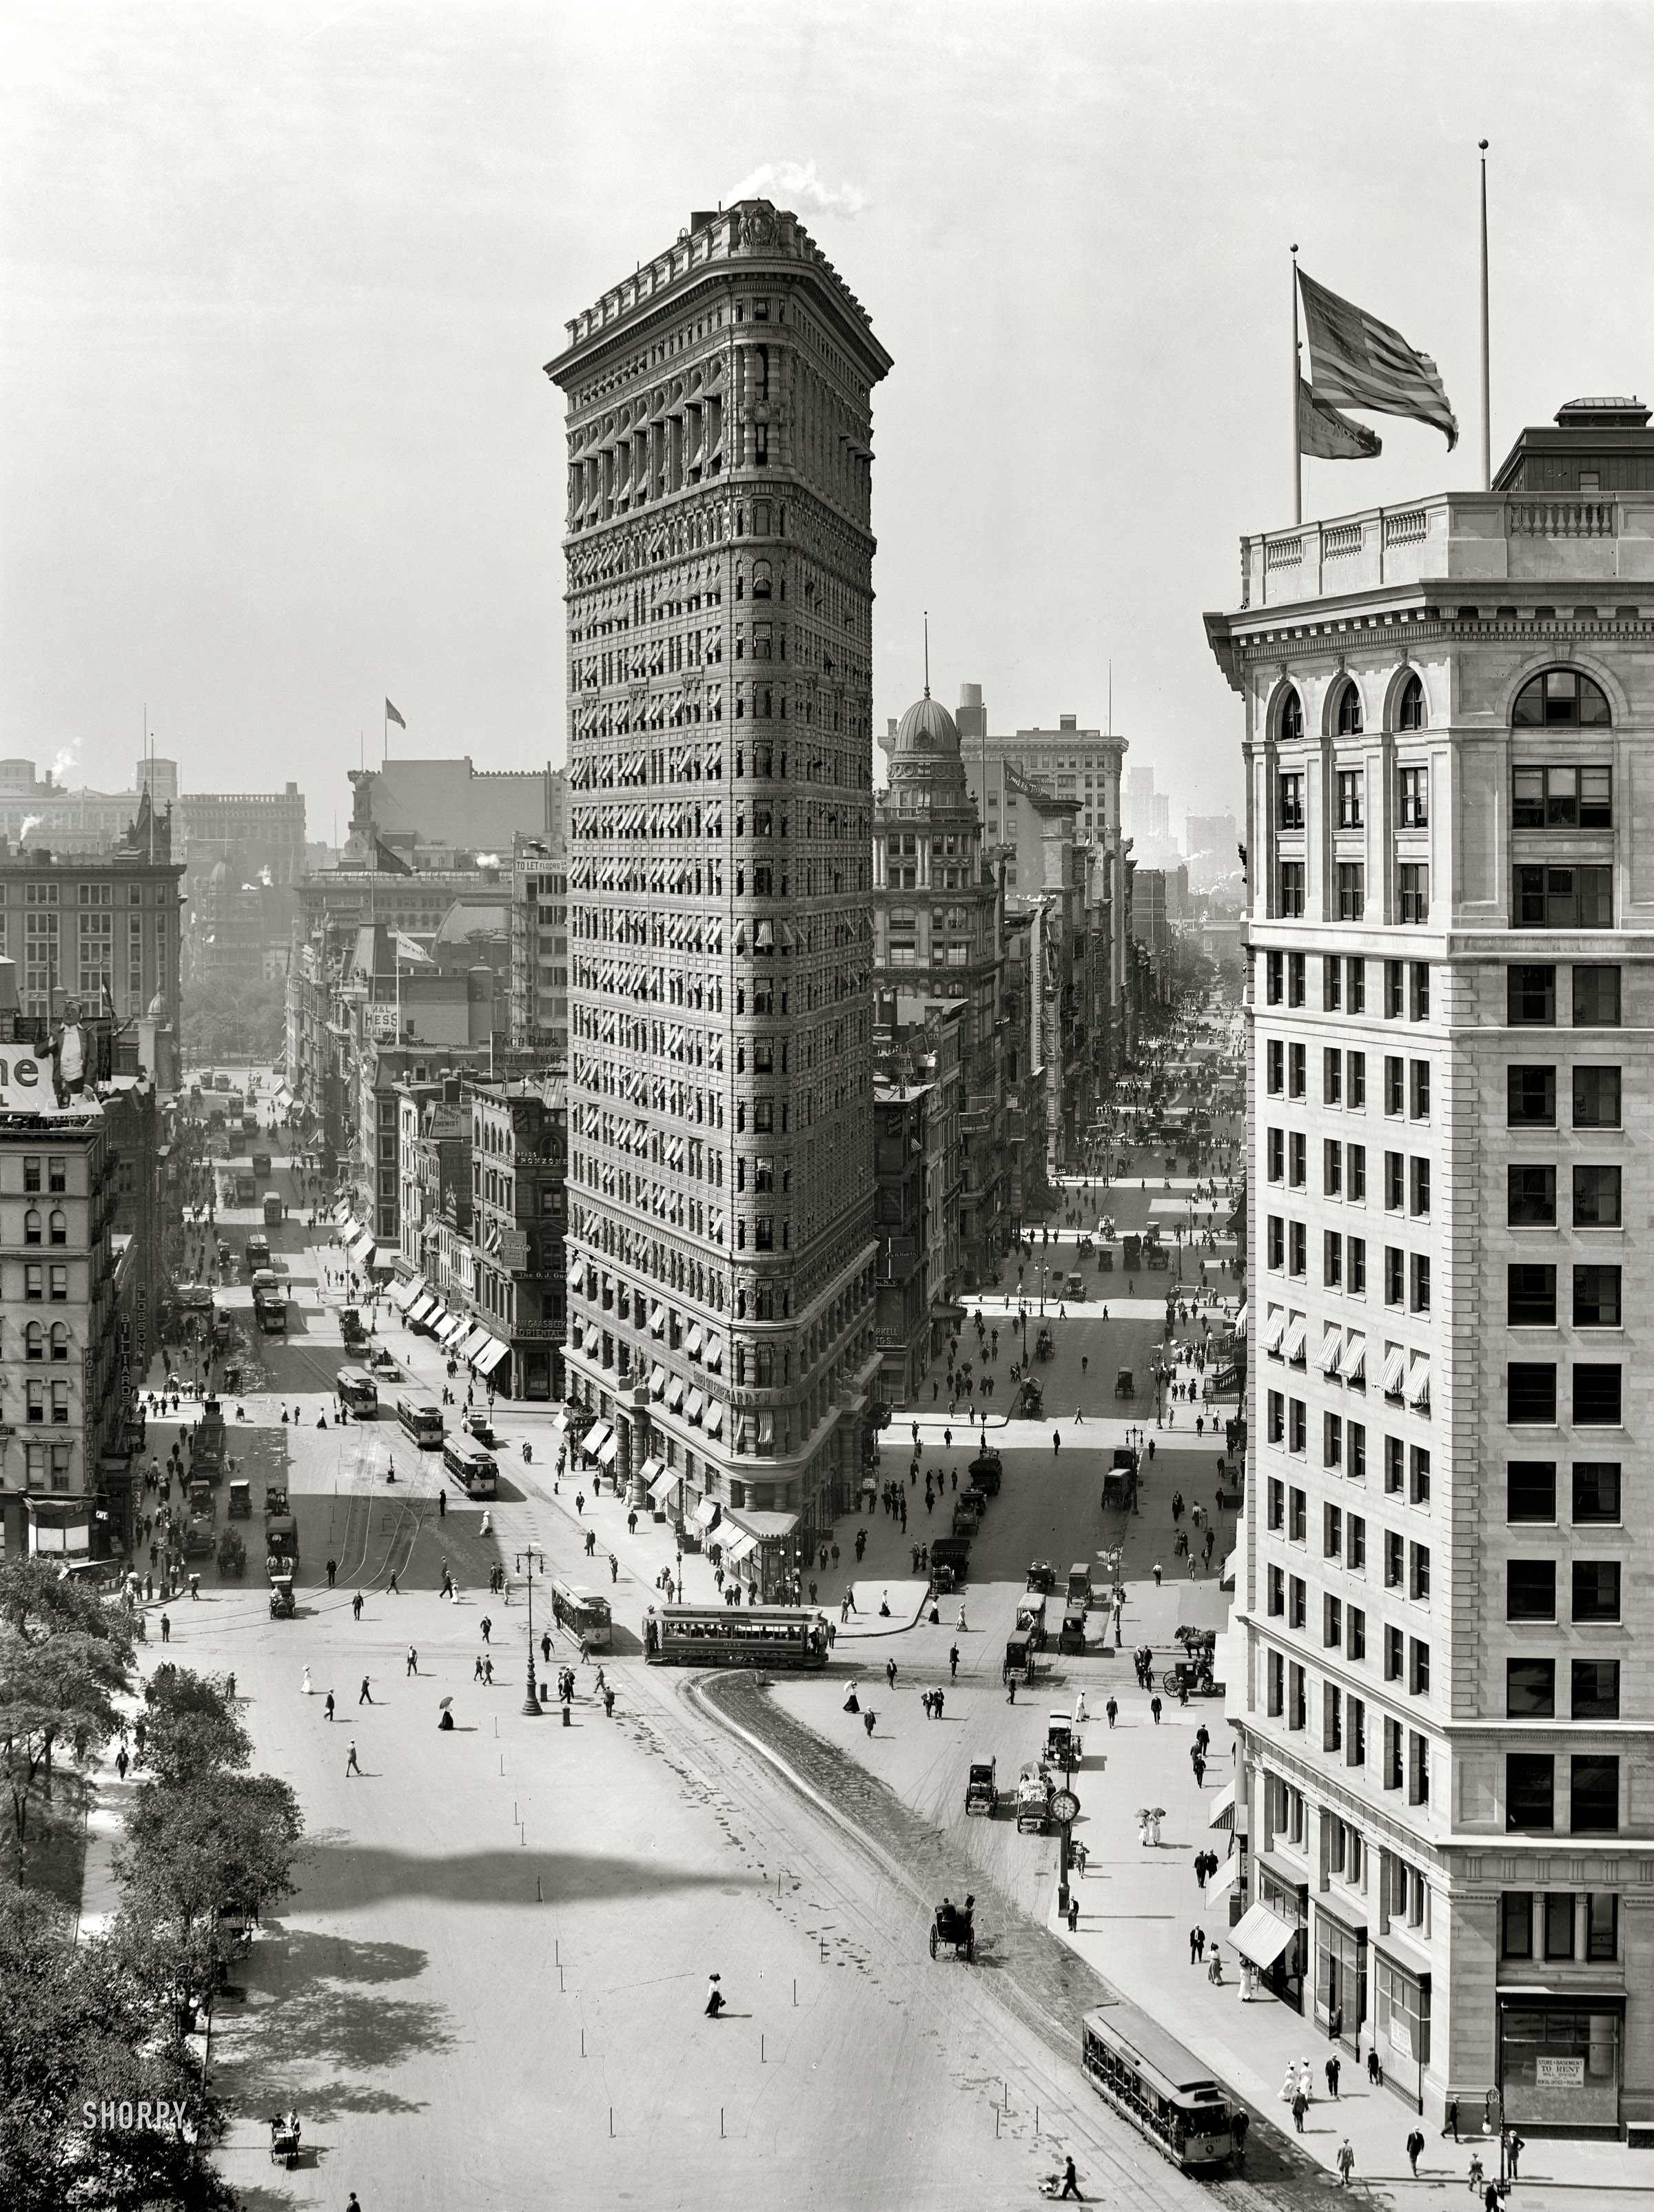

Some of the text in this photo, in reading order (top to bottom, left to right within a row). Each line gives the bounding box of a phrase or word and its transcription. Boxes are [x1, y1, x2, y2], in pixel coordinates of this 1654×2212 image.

[1006, 772, 1021, 786] Lord
[517, 861, 525, 870] TO
[527, 861, 539, 870] LET
[365, 1012, 398, 1027] HESS
[493, 1054, 561, 1064] PHOTOGRAPHERS
[437, 1104, 460, 1120] HUDNUT
[528, 1320, 566, 1329] GAASBEEK
[519, 1329, 561, 1337] ORIENTAL
[121, 1313, 130, 1405] BILLIARDS
